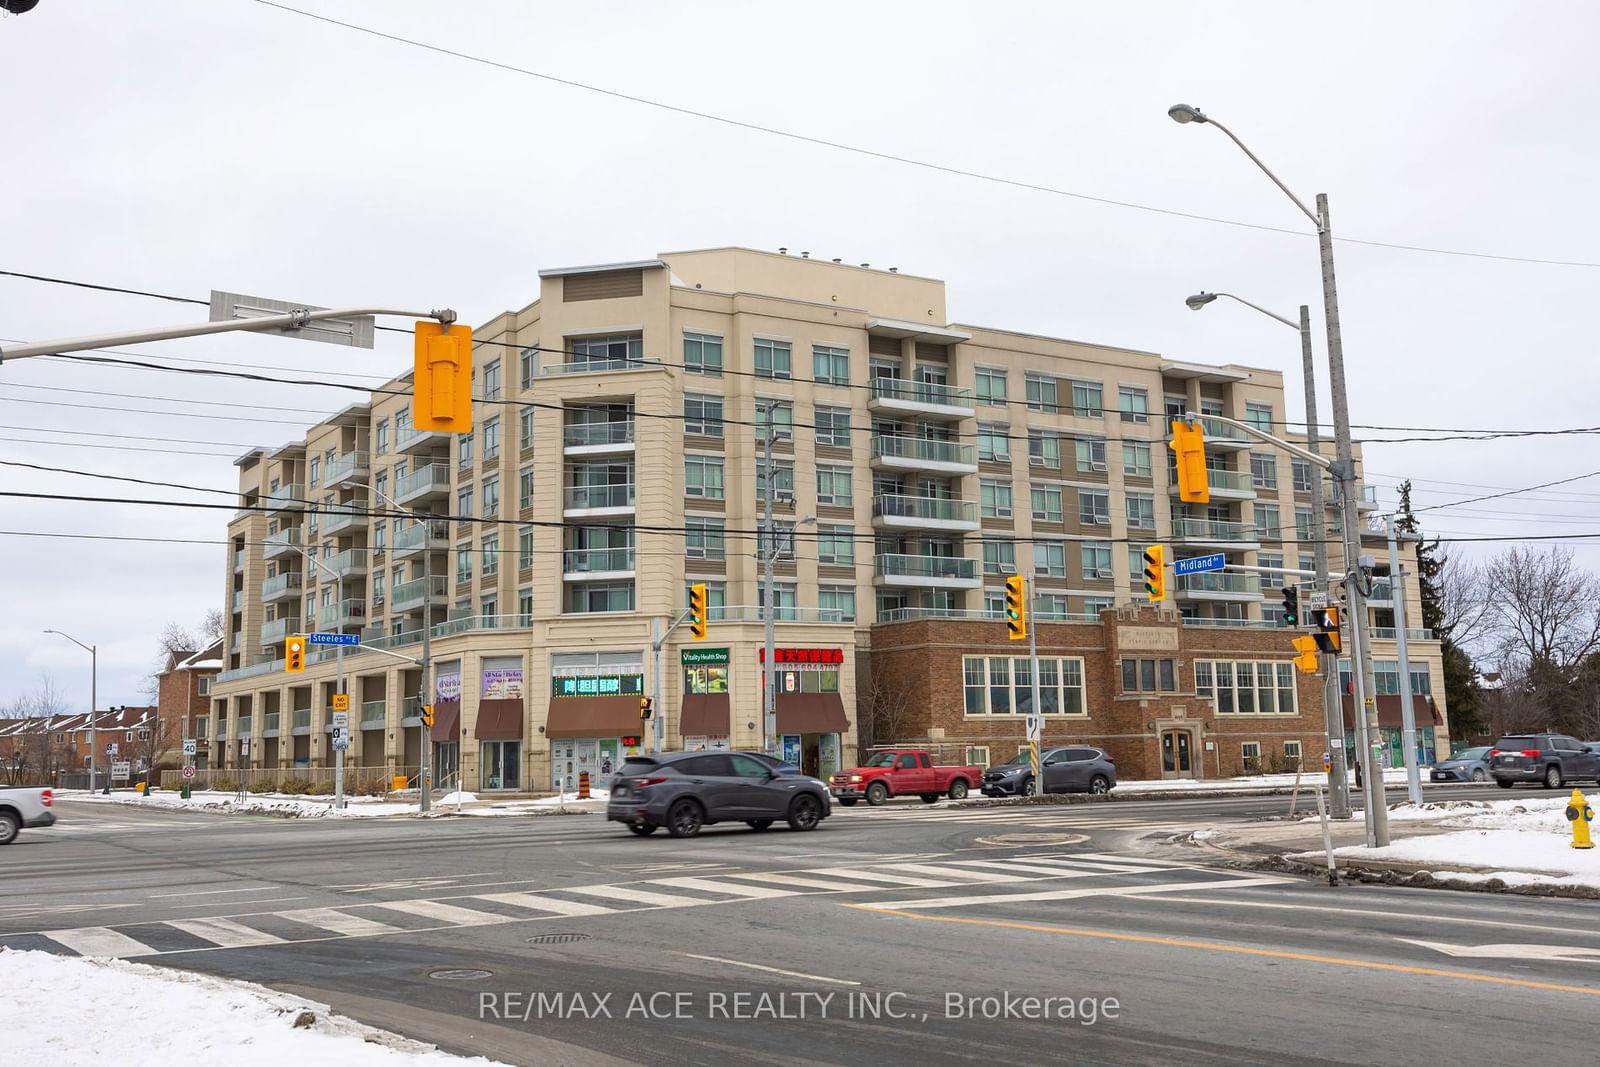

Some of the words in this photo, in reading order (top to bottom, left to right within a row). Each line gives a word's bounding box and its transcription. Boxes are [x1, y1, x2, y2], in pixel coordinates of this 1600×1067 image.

[1180, 557, 1213, 571] Midland
[313, 634, 343, 642] Steeles
[351, 635, 357, 643] E
[683, 653, 700, 661] Vitality
[715, 653, 727, 661] Shop
